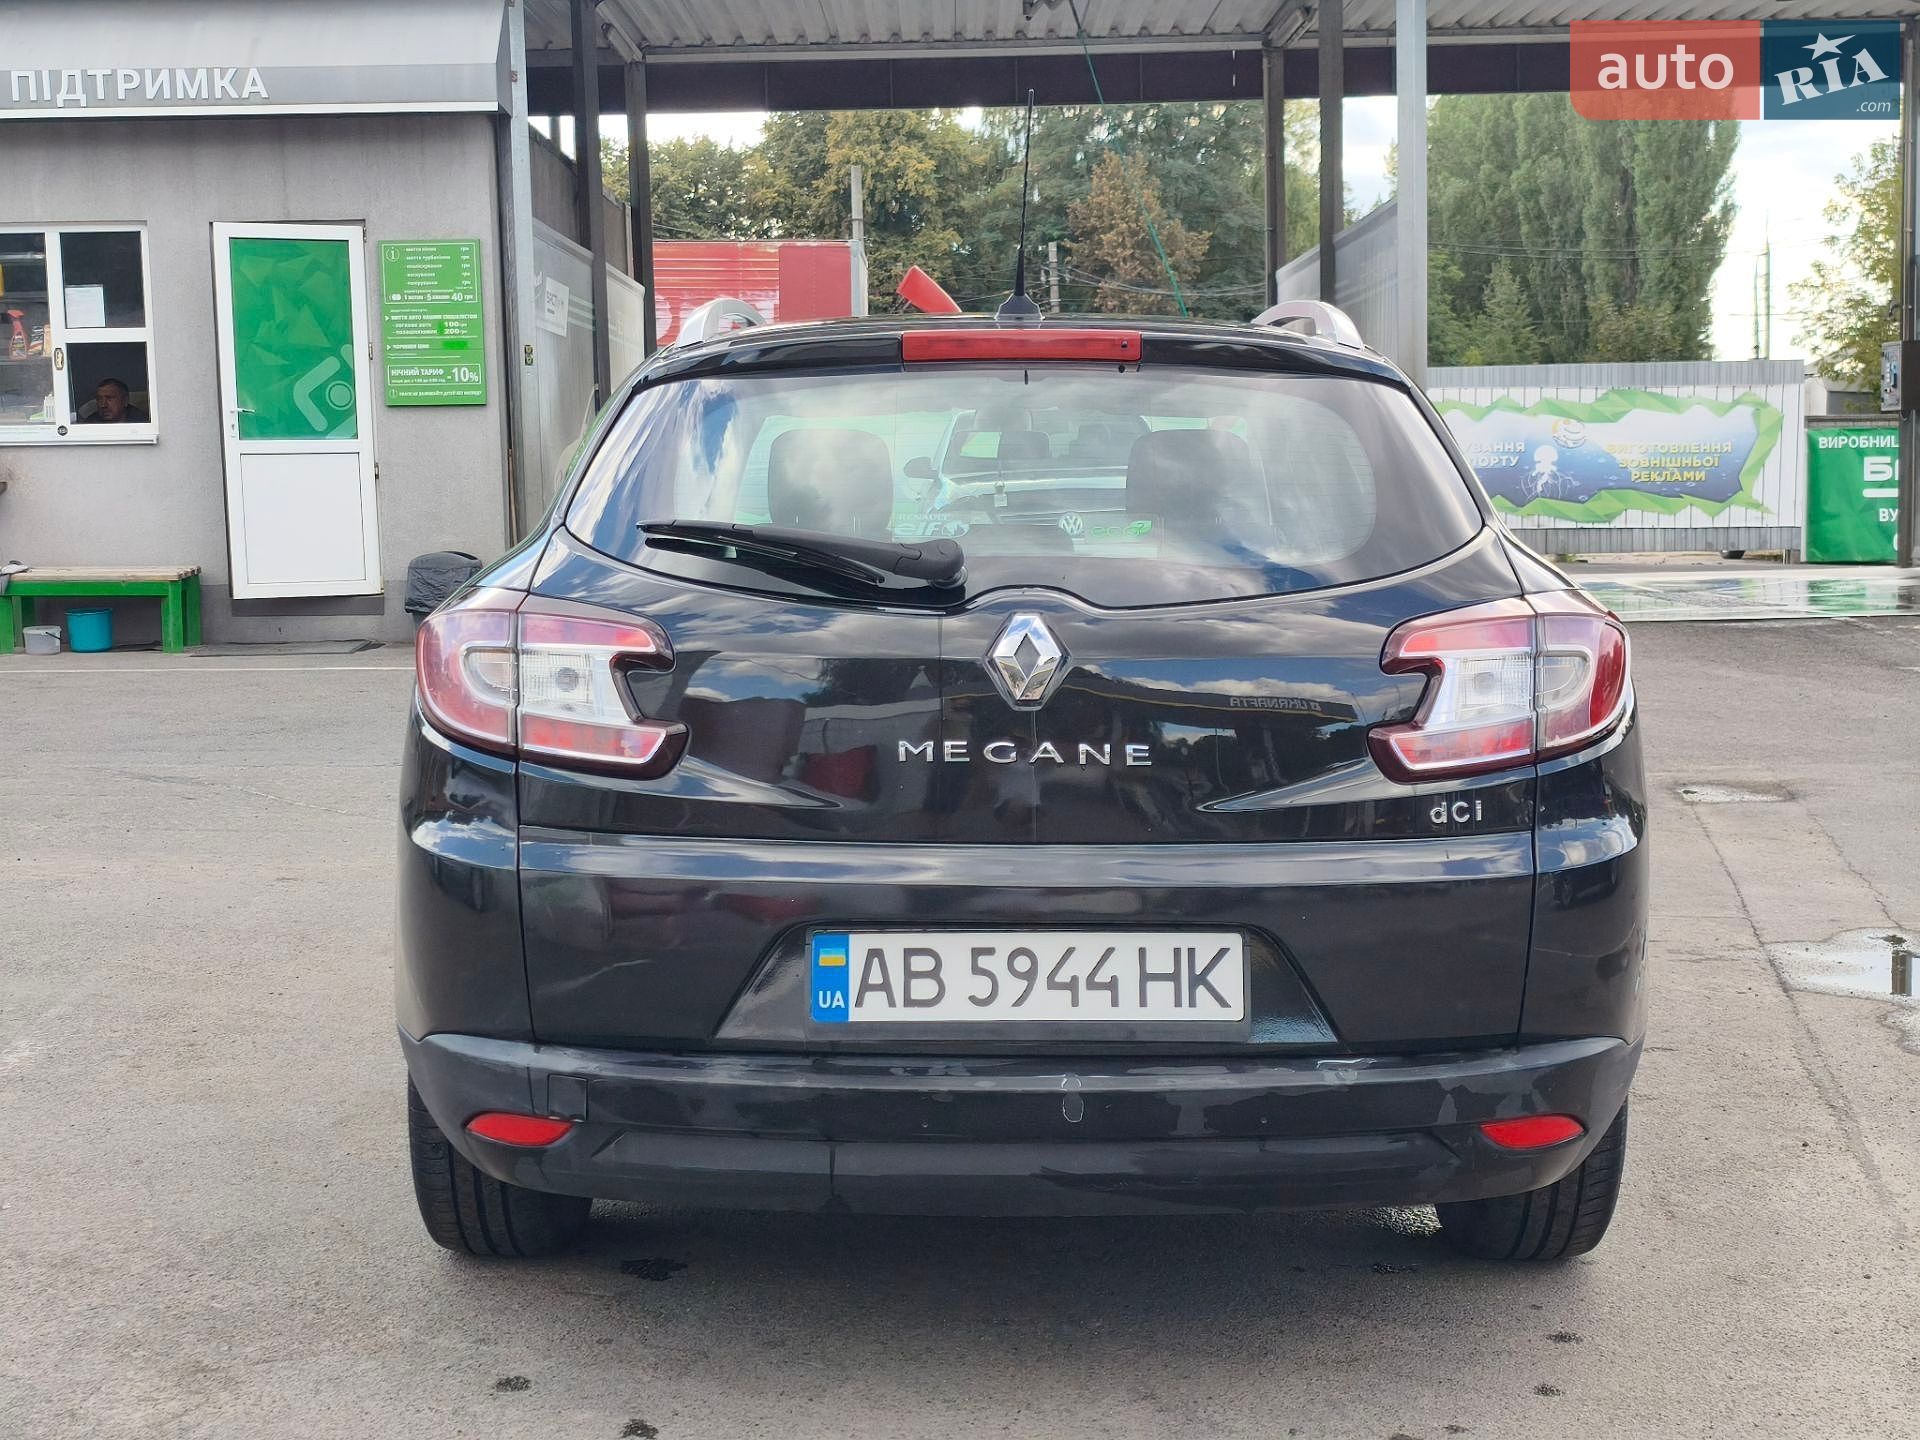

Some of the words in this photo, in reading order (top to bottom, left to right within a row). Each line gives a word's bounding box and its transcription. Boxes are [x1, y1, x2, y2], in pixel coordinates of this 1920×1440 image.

[10, 67, 269, 108] ПІДТРИМКА
[1619, 454, 1720, 468] ЗОВНІШНЬОЇ
[1631, 469, 1706, 482] РЕКЛАМИ
[898, 740, 1153, 766] MEGANE
[854, 948, 946, 1008] AB
[967, 947, 1119, 1008] 5944
[1138, 947, 1232, 1008] HK
[818, 991, 846, 1009] UA
